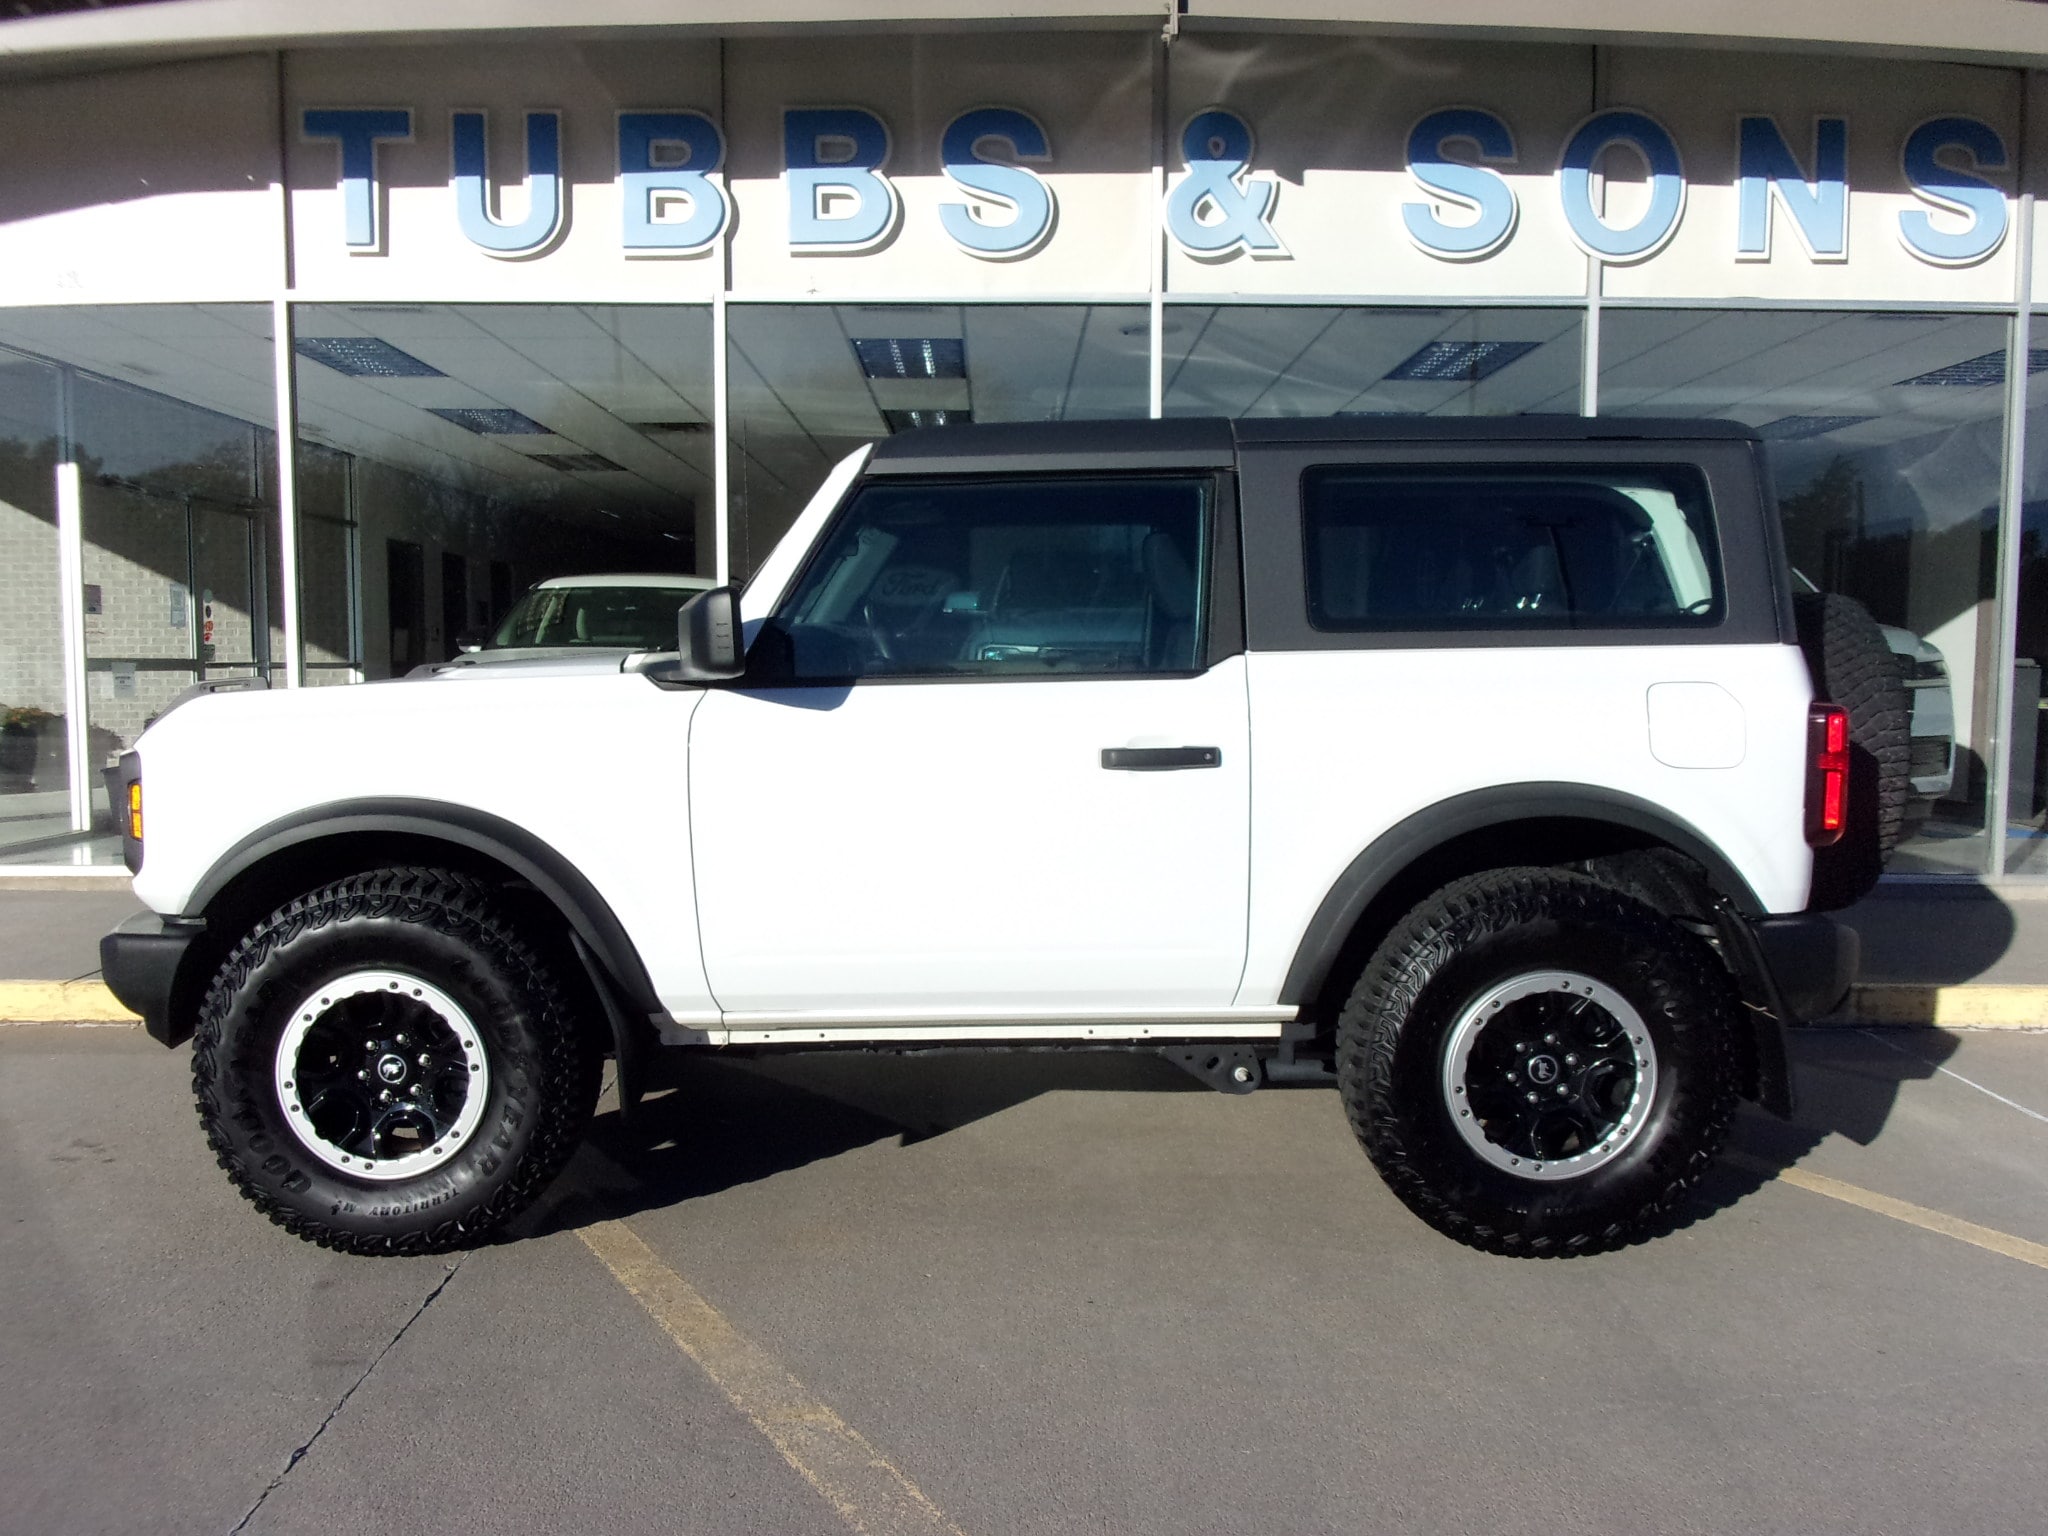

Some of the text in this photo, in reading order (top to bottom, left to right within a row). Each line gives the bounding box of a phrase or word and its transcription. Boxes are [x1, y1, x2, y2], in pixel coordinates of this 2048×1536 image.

[299, 106, 2010, 265] TUBBS & SONS
[368, 1187, 461, 1217] TERRITORY
